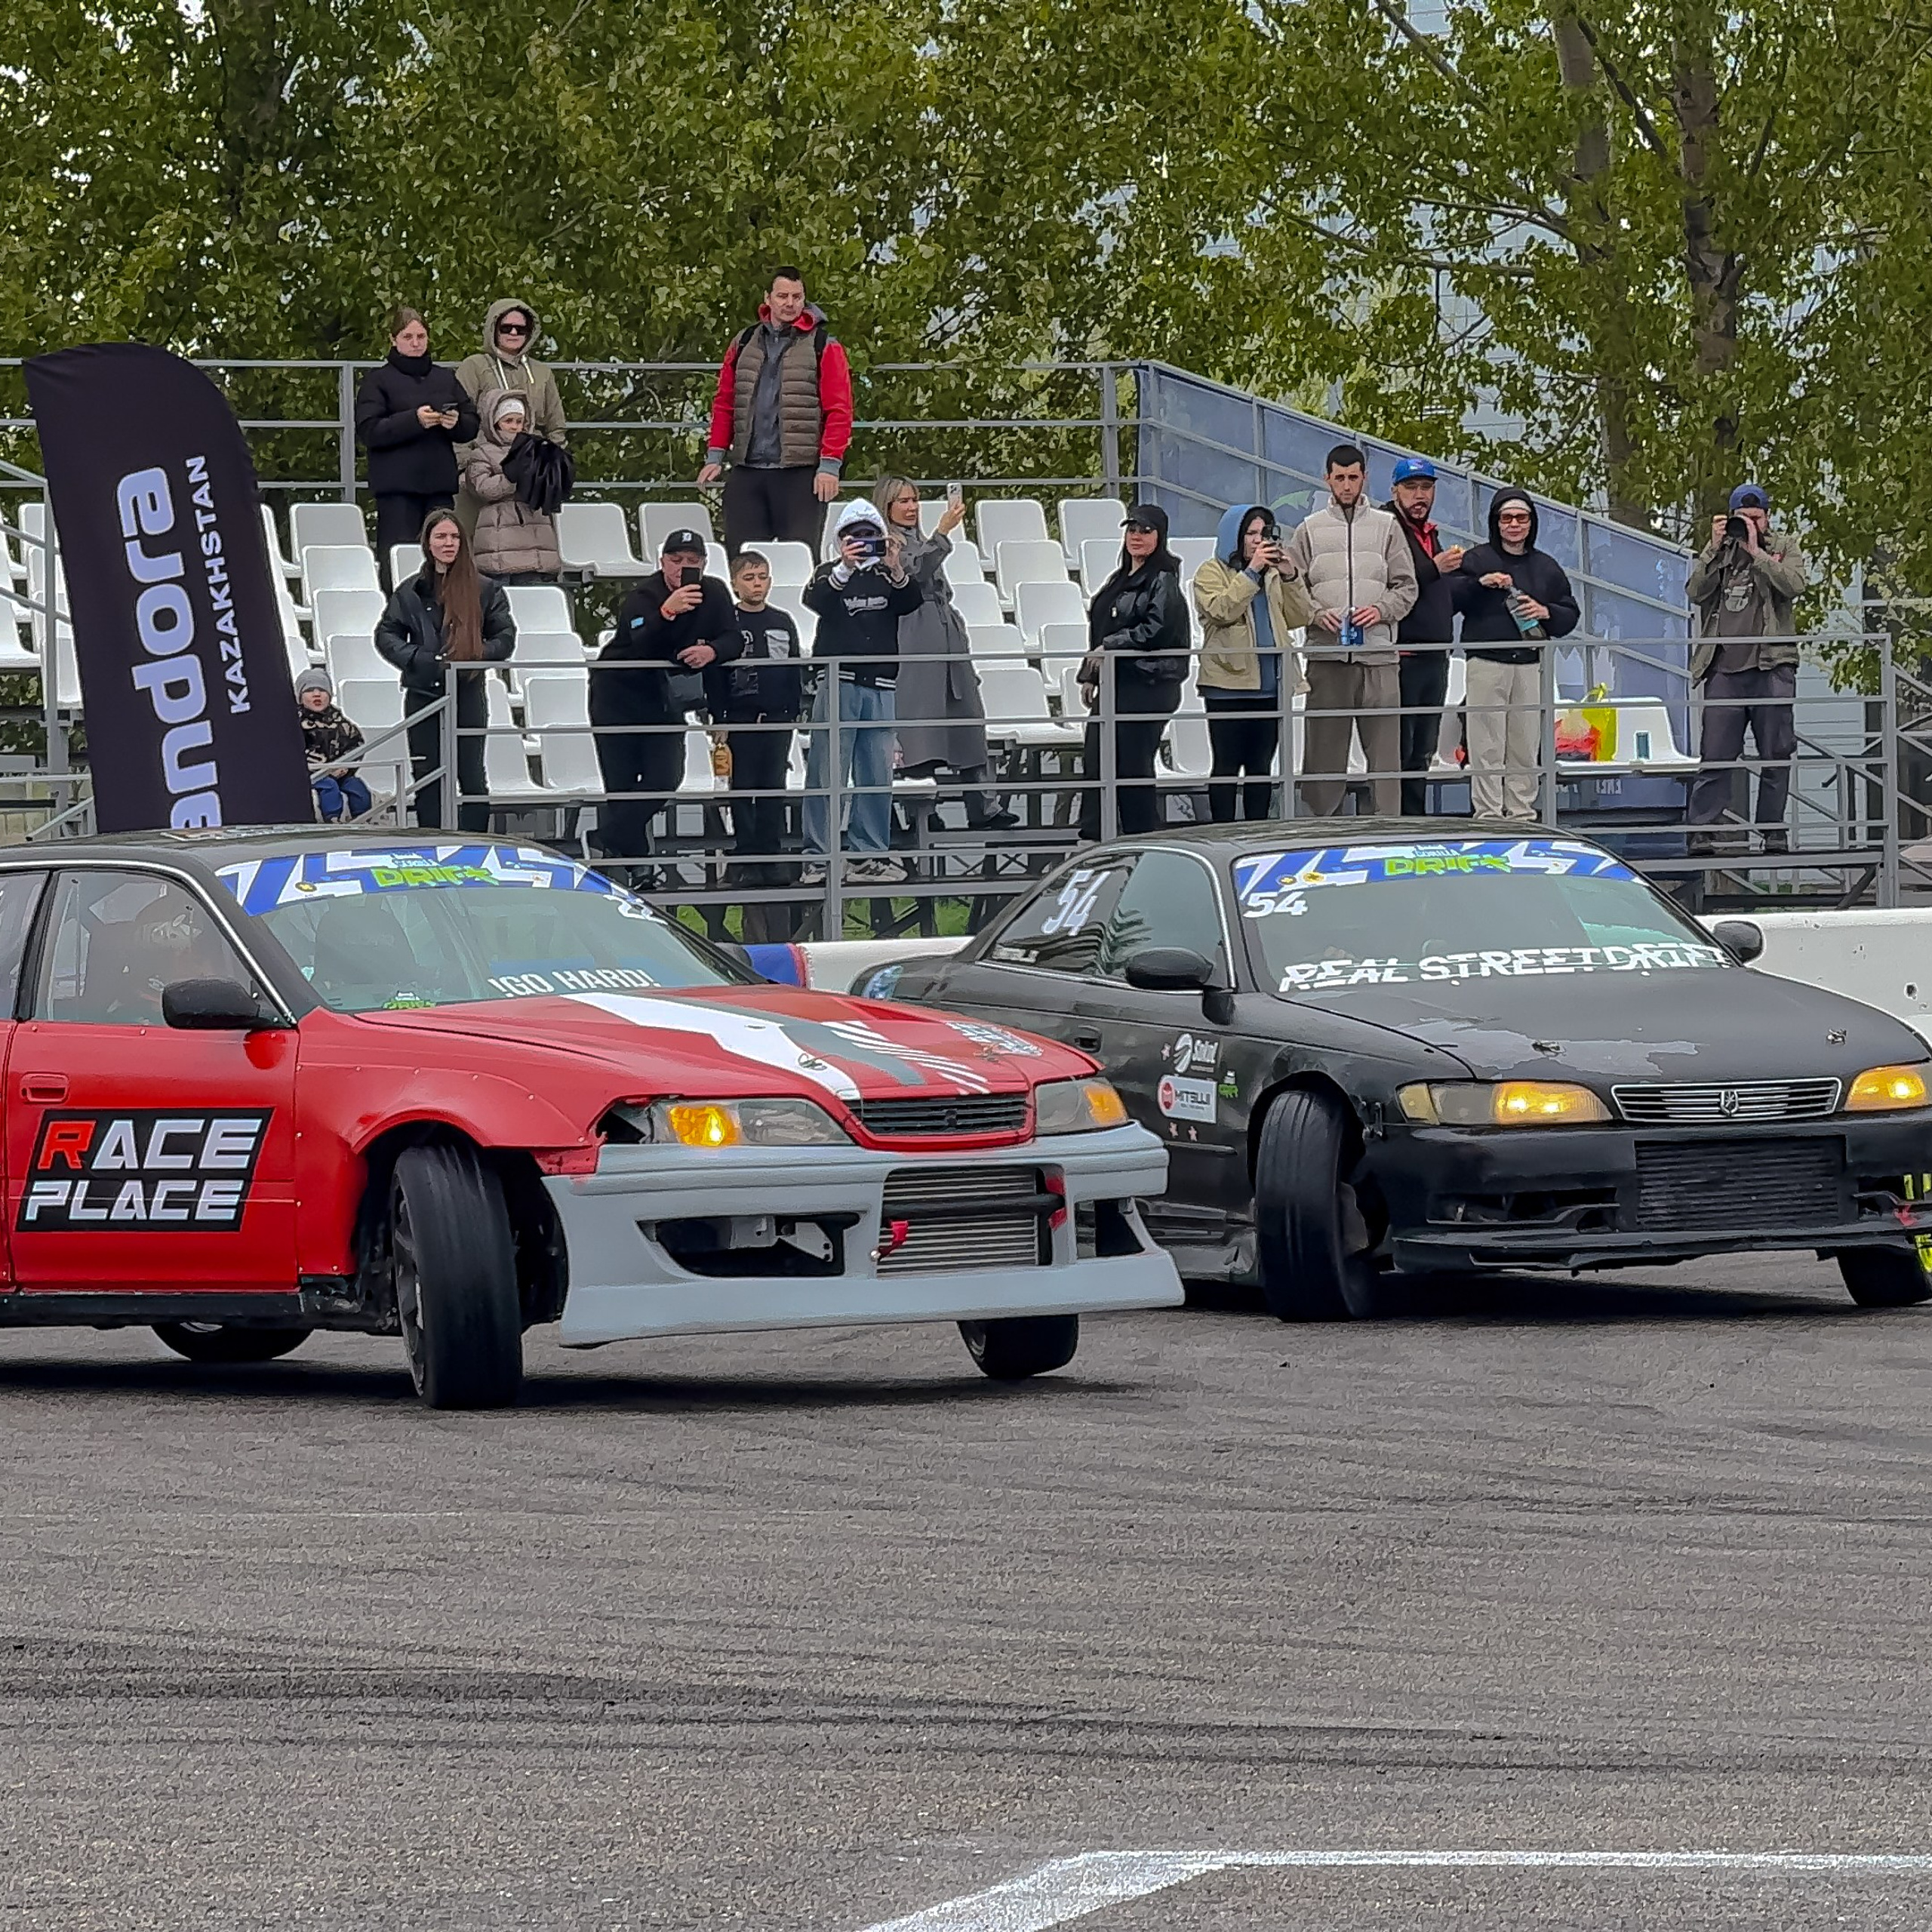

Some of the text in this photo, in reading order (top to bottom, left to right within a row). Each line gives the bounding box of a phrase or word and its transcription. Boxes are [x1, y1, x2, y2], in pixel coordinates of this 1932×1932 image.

[186, 455, 251, 714] KAZAKHSTAN
[1042, 869, 1111, 936] 54
[1243, 891, 1309, 918] 54
[552, 969, 661, 989] HARD!
[1279, 958, 1409, 992] REAL
[38, 1118, 263, 1170] RACE
[24, 1180, 245, 1221] PLACE
